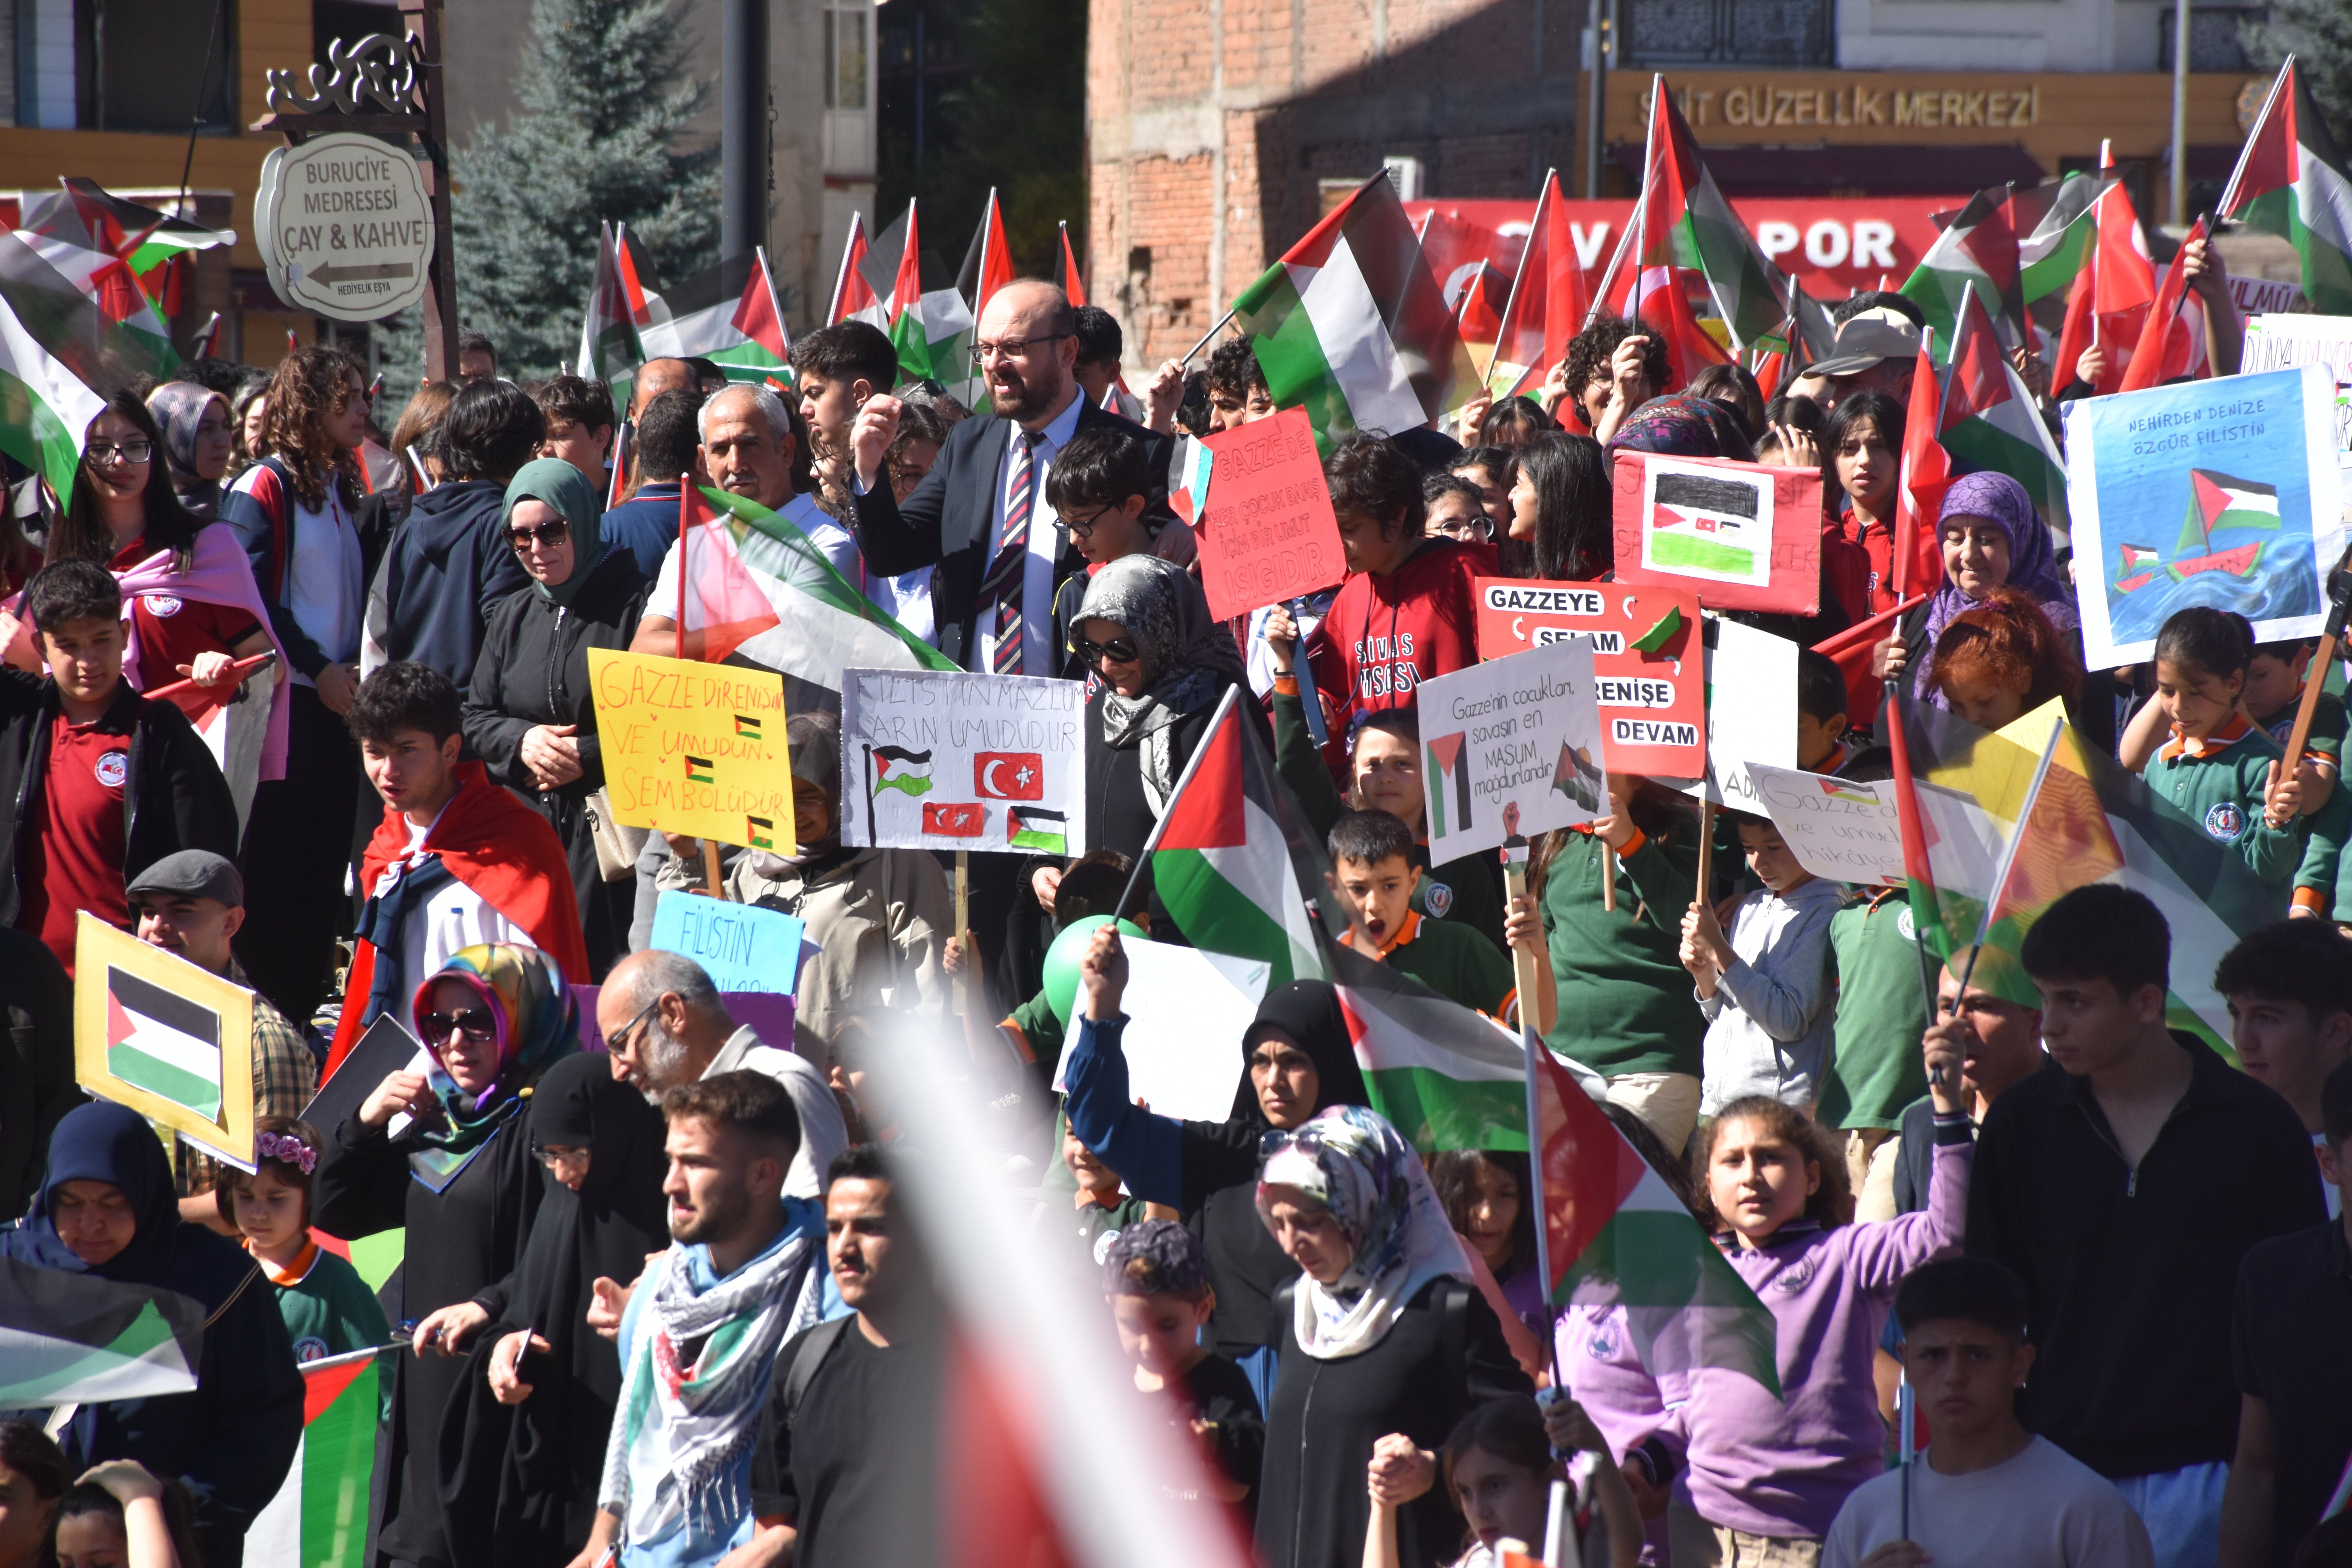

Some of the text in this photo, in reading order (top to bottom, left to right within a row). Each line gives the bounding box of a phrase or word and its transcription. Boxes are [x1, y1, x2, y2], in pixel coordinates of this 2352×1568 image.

[1726, 83, 1883, 127] GÜZELLİK
[1895, 85, 2037, 127] MERKEZİ
[306, 156, 391, 184] BURUCİYE
[304, 185, 398, 214] MEDRESESİ
[285, 220, 424, 259] ÇAY & KAHVE
[338, 281, 391, 296] HEDİYELİK EŞYA
[2129, 399, 2266, 433] NEHİRDEN DENİZE
[2134, 421, 2265, 455] ÖZGÜR FİLİSTİN
[1209, 506, 1238, 531] HER
[1240, 489, 1286, 525] ÇOCUK
[1219, 513, 1310, 559] İÇİN BİR UMUT
[1490, 589, 1599, 613] GAZZEYE
[1355, 632, 1414, 664] SİVAS
[600, 661, 697, 709] GAZZE
[997, 684, 1085, 712] MAZLUM
[1452, 692, 1508, 720] Gazze'nin
[607, 719, 763, 761] VE UMUDUN
[856, 714, 1077, 752] LARIN UMUDUDUR
[1472, 710, 1543, 745] savaşın en
[1616, 720, 1696, 746] DEVAM
[1485, 739, 1537, 770] MASUM
[621, 766, 788, 822] SEMBOLÜDÜR
[1762, 773, 1873, 818] Gazze
[1786, 822, 1899, 844] ve umud
[680, 905, 756, 967] FİLİSTİN
